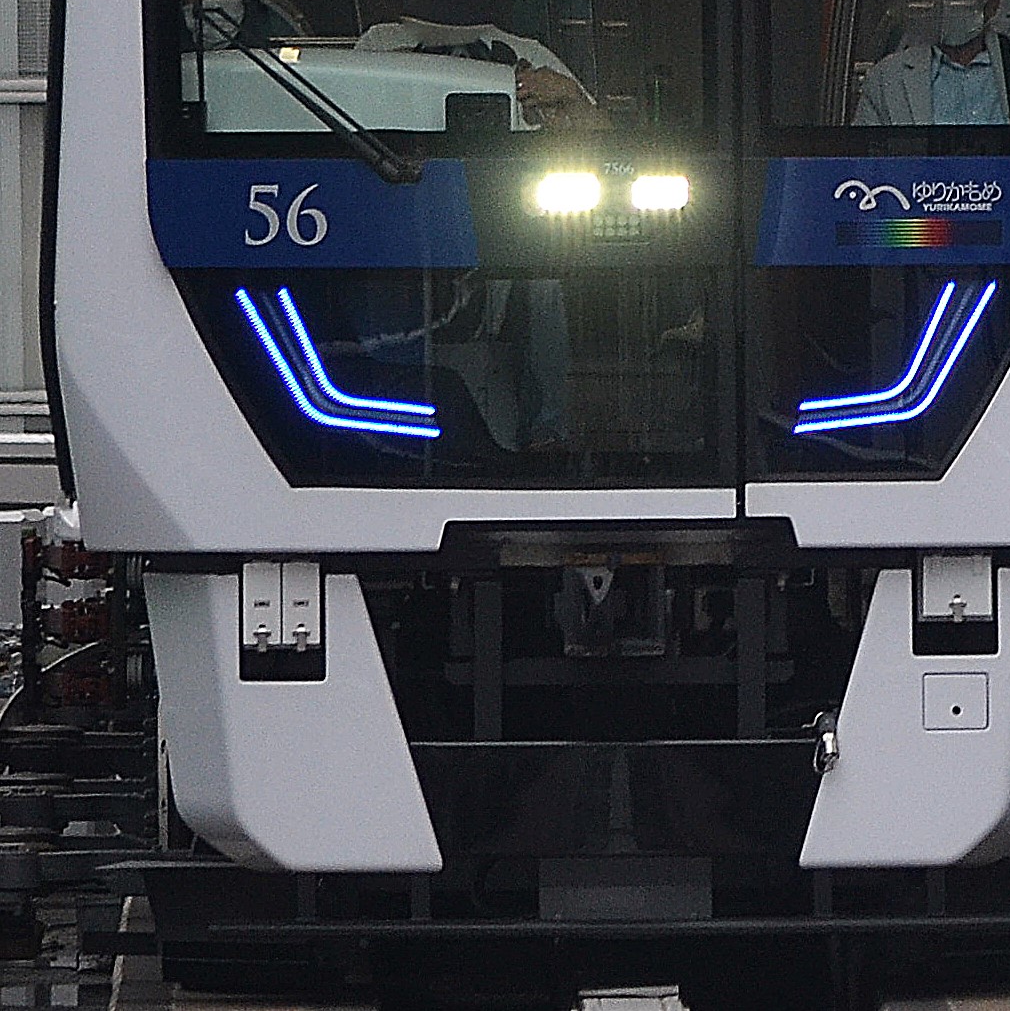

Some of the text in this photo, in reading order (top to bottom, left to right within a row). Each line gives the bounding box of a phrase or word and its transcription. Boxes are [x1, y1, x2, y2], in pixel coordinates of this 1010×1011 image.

[912, 180, 1002, 203] ゆりかもめ
[245, 183, 328, 246] 56
[923, 202, 993, 212] YURIKAMOME
